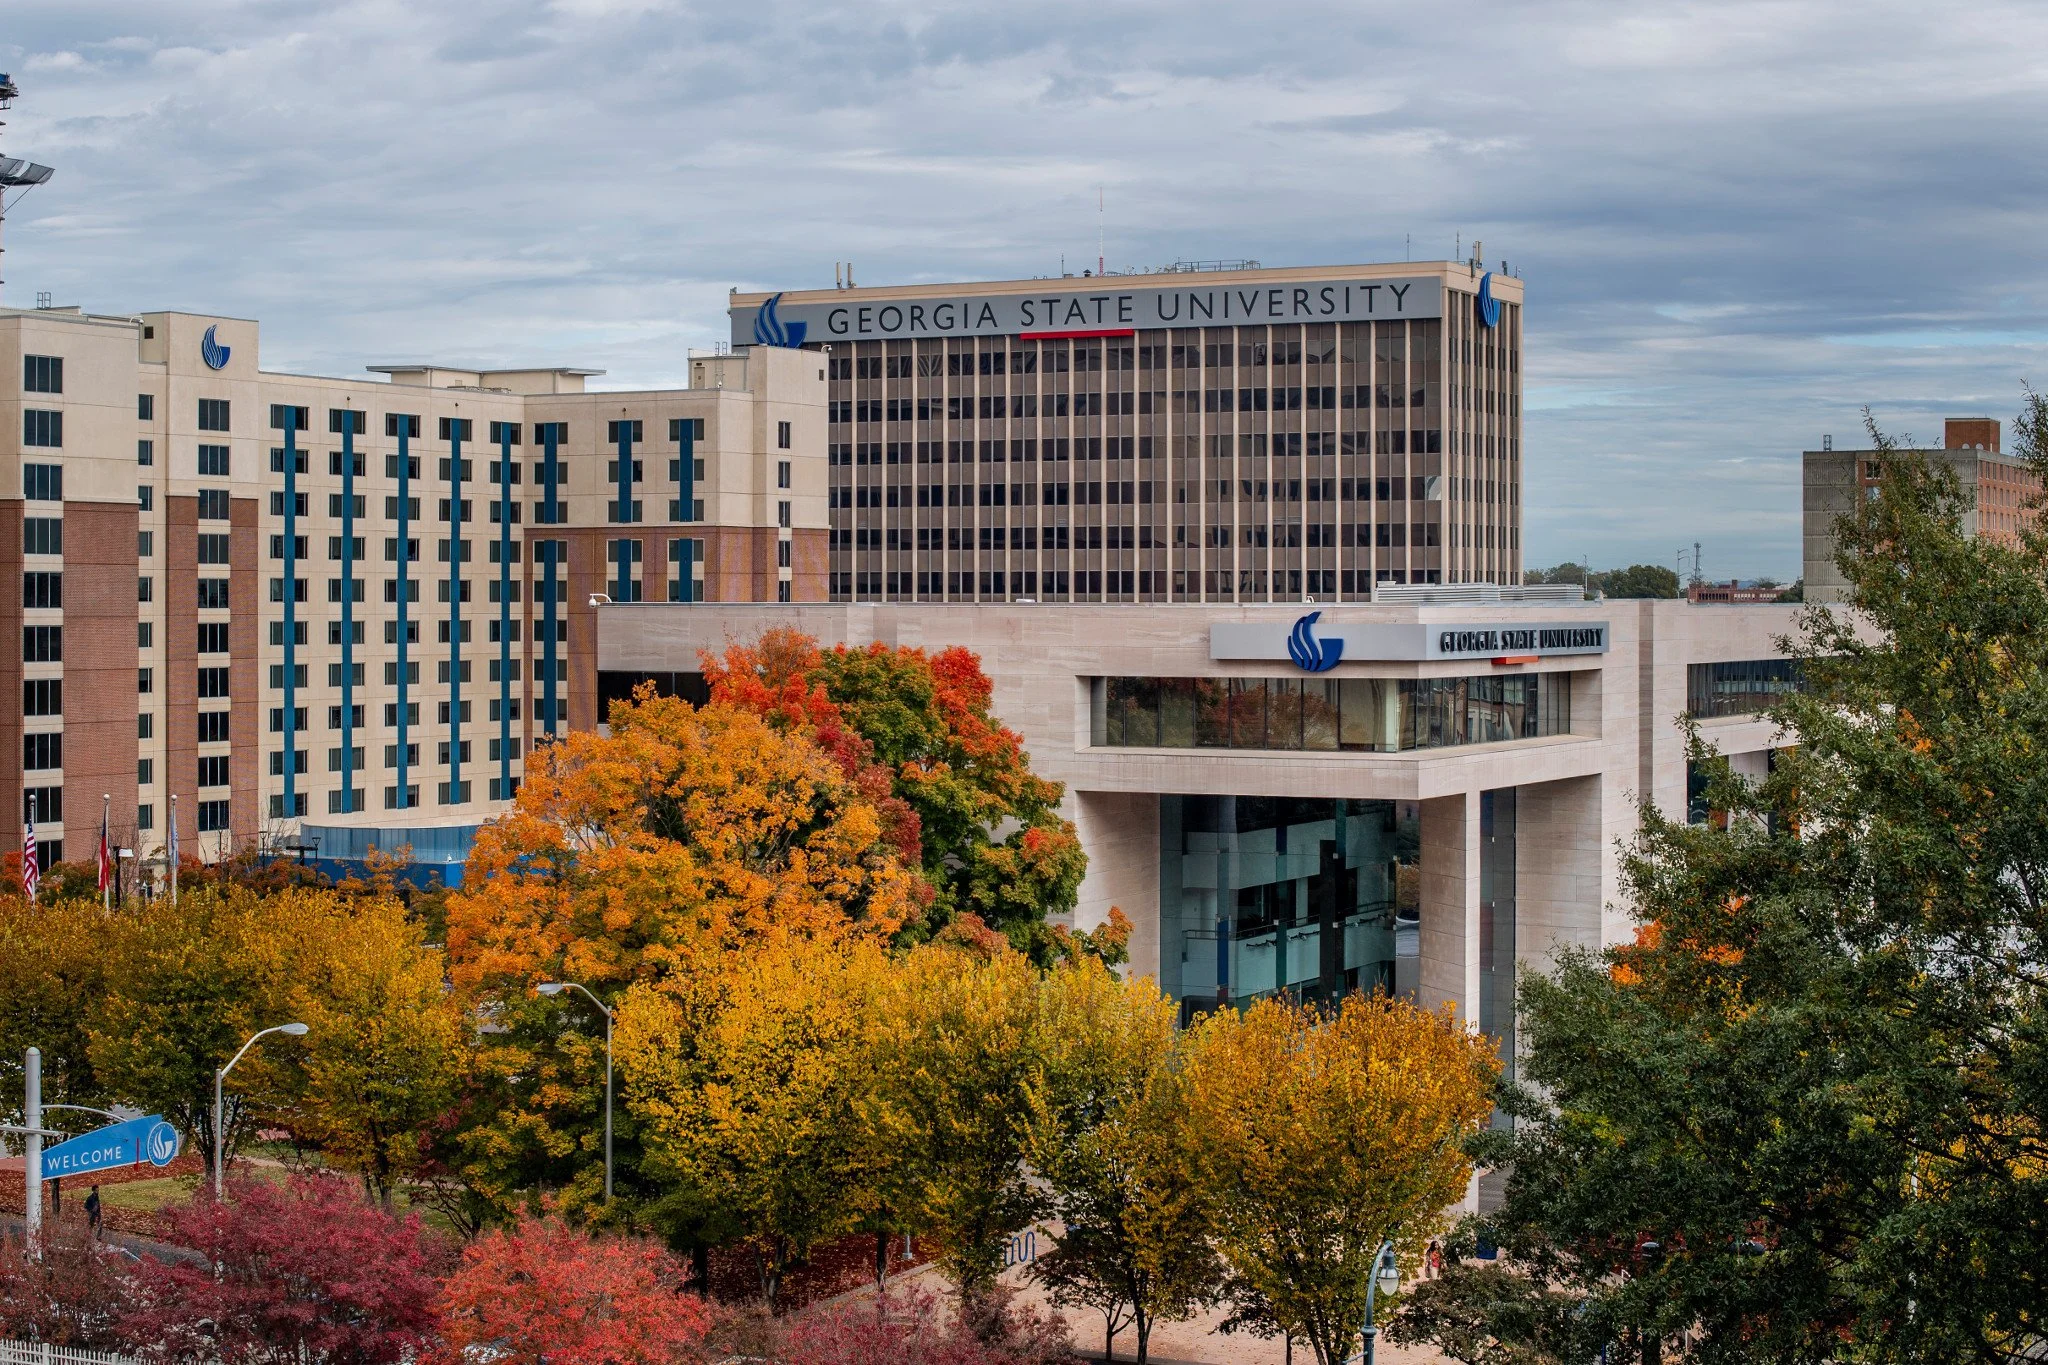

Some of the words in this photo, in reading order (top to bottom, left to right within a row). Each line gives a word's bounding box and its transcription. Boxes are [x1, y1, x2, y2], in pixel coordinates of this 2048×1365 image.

[828, 302, 998, 335] GEORGIA
[1020, 295, 1133, 327] STATE
[1157, 283, 1412, 322] UNIVERSITY
[1440, 630, 1499, 652] GEORGIA
[1501, 629, 1537, 650] STATE
[1539, 628, 1604, 649] UNIVERSITY
[48, 1147, 122, 1170] WELCOME
